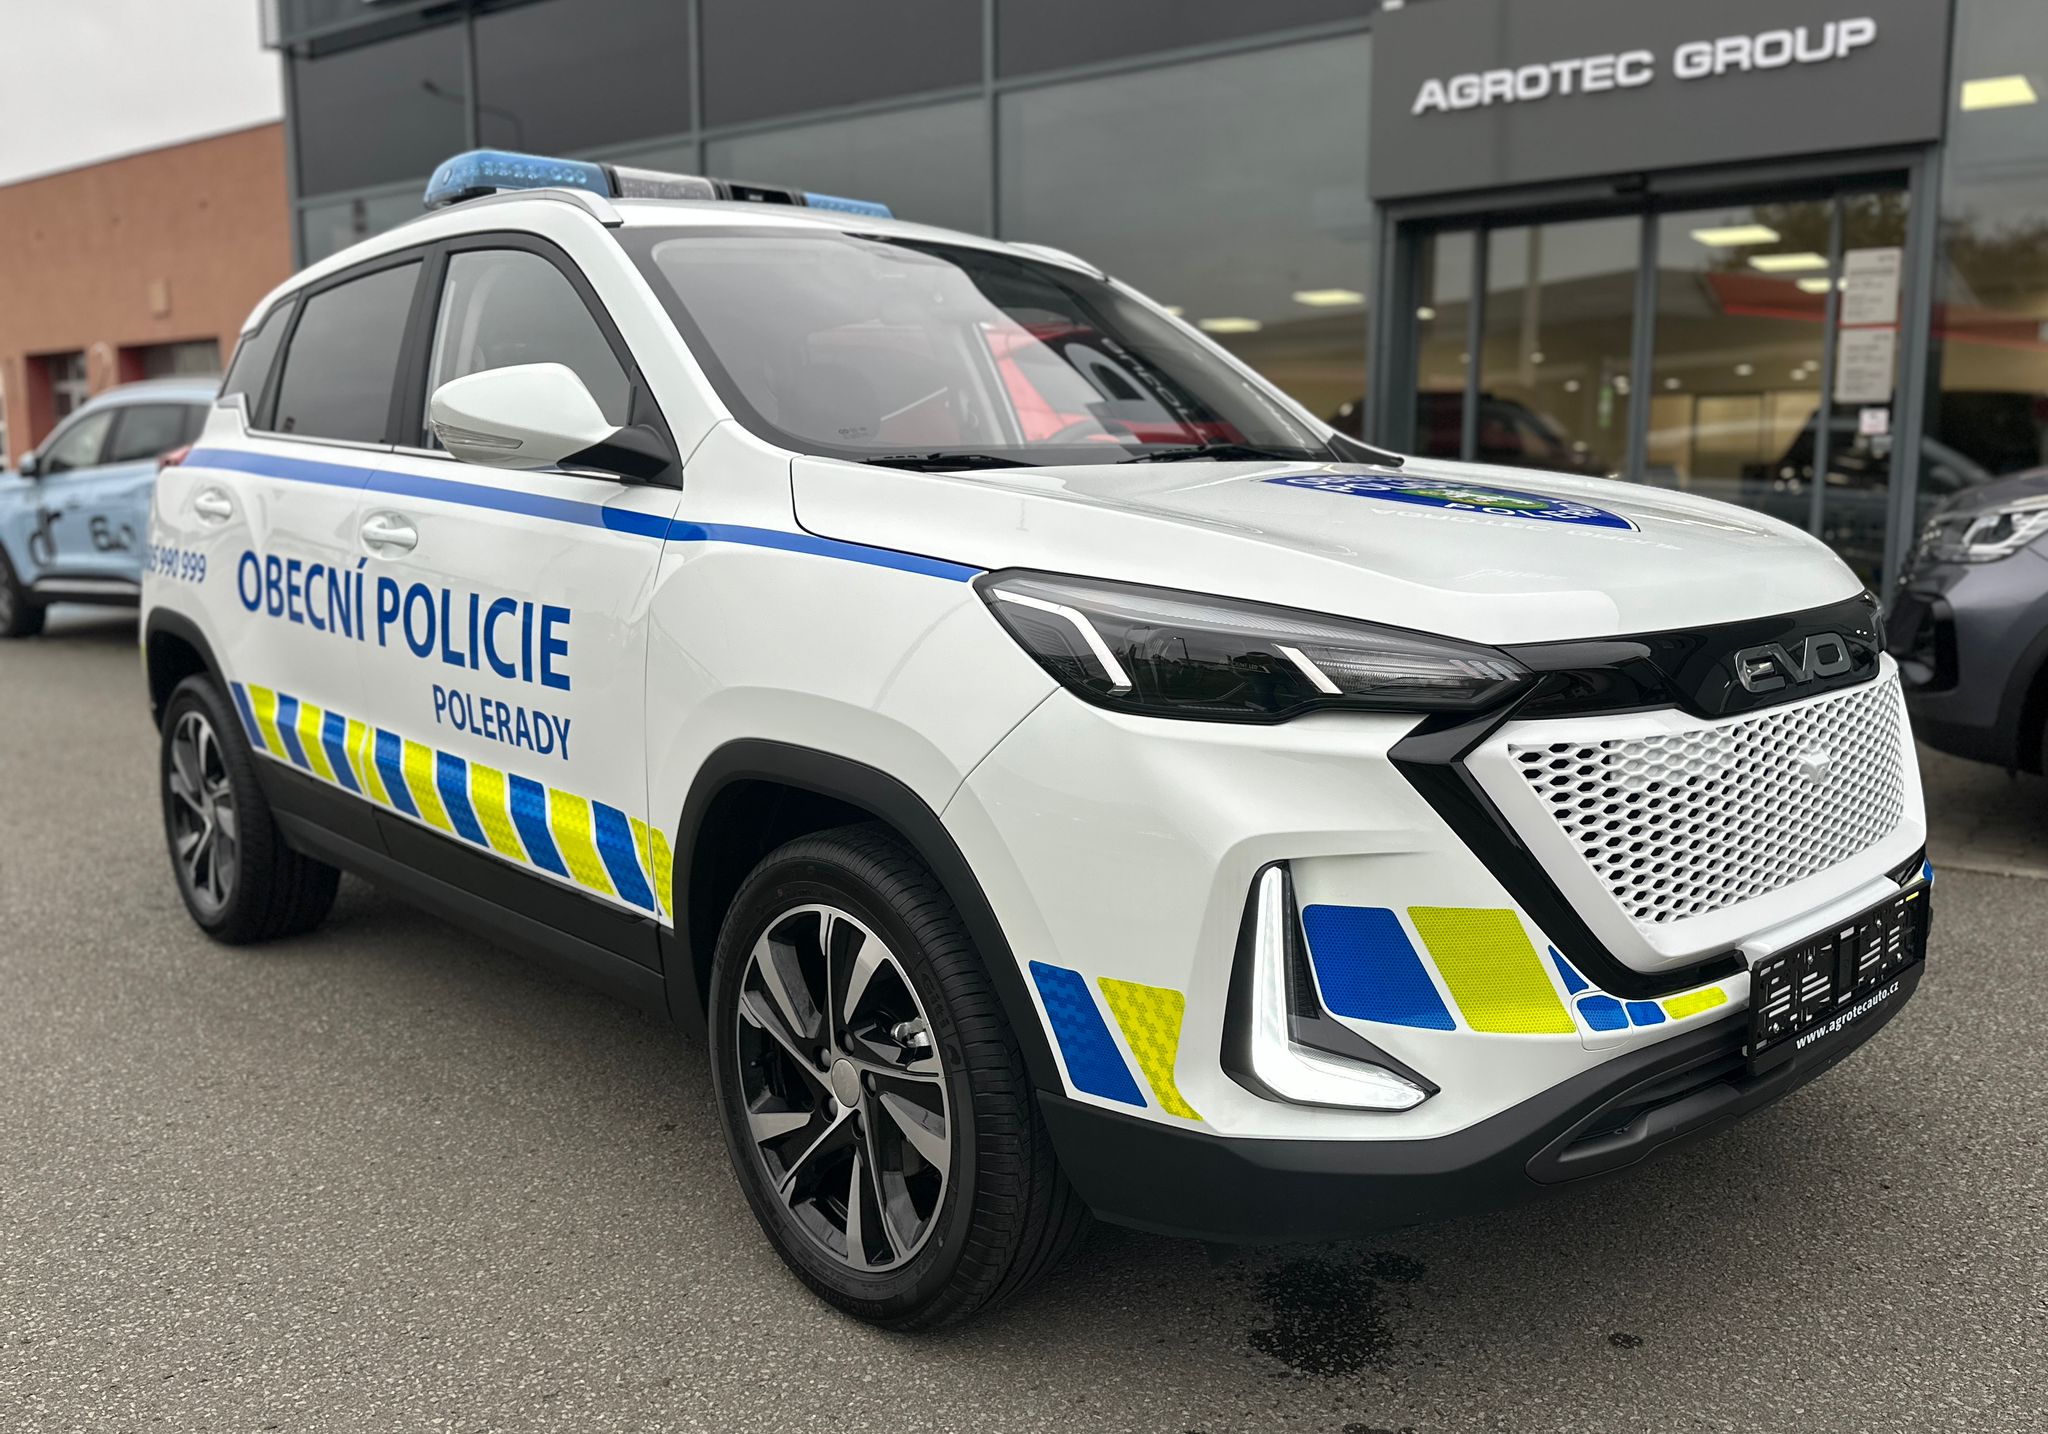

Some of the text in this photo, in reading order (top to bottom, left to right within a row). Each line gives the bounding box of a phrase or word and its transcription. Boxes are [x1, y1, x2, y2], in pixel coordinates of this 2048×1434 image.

[1411, 17, 1876, 114] AGROTEC GROUP
[181, 550, 206, 583] 999
[238, 550, 571, 691] OBECNÍ POLICIE
[1734, 631, 1851, 693] EVO
[432, 684, 571, 760] POLERADY
[1796, 981, 1899, 1049] www.agrotecauto.cz
